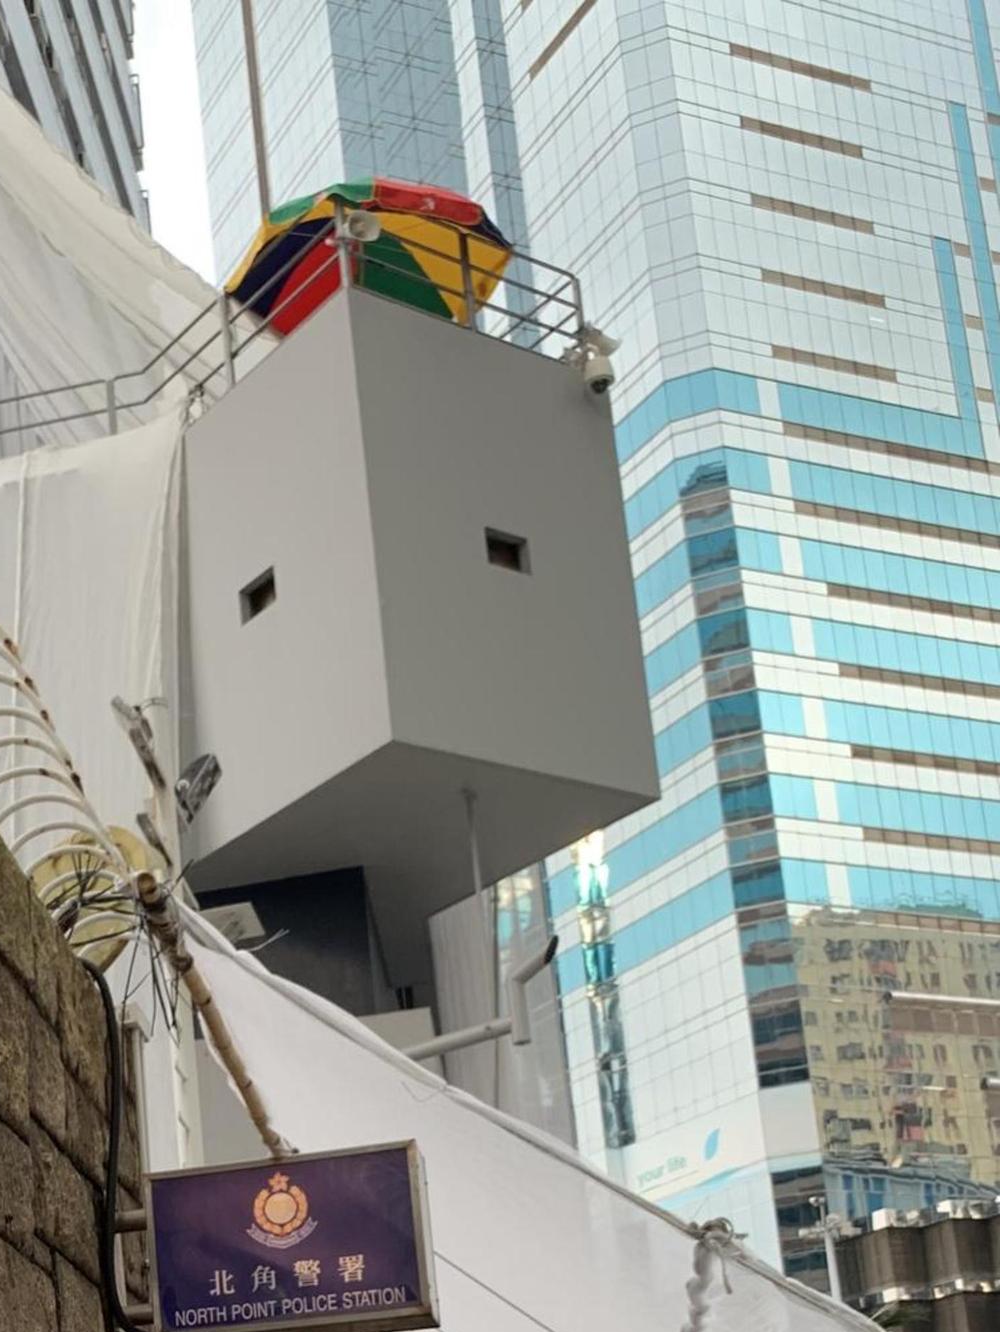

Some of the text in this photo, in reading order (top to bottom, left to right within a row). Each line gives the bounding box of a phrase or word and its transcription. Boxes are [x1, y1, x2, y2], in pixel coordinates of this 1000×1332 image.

[209, 1254, 365, 1296] 北角警署
[175, 1286, 406, 1327] NORTH POINT POLICE STATION
